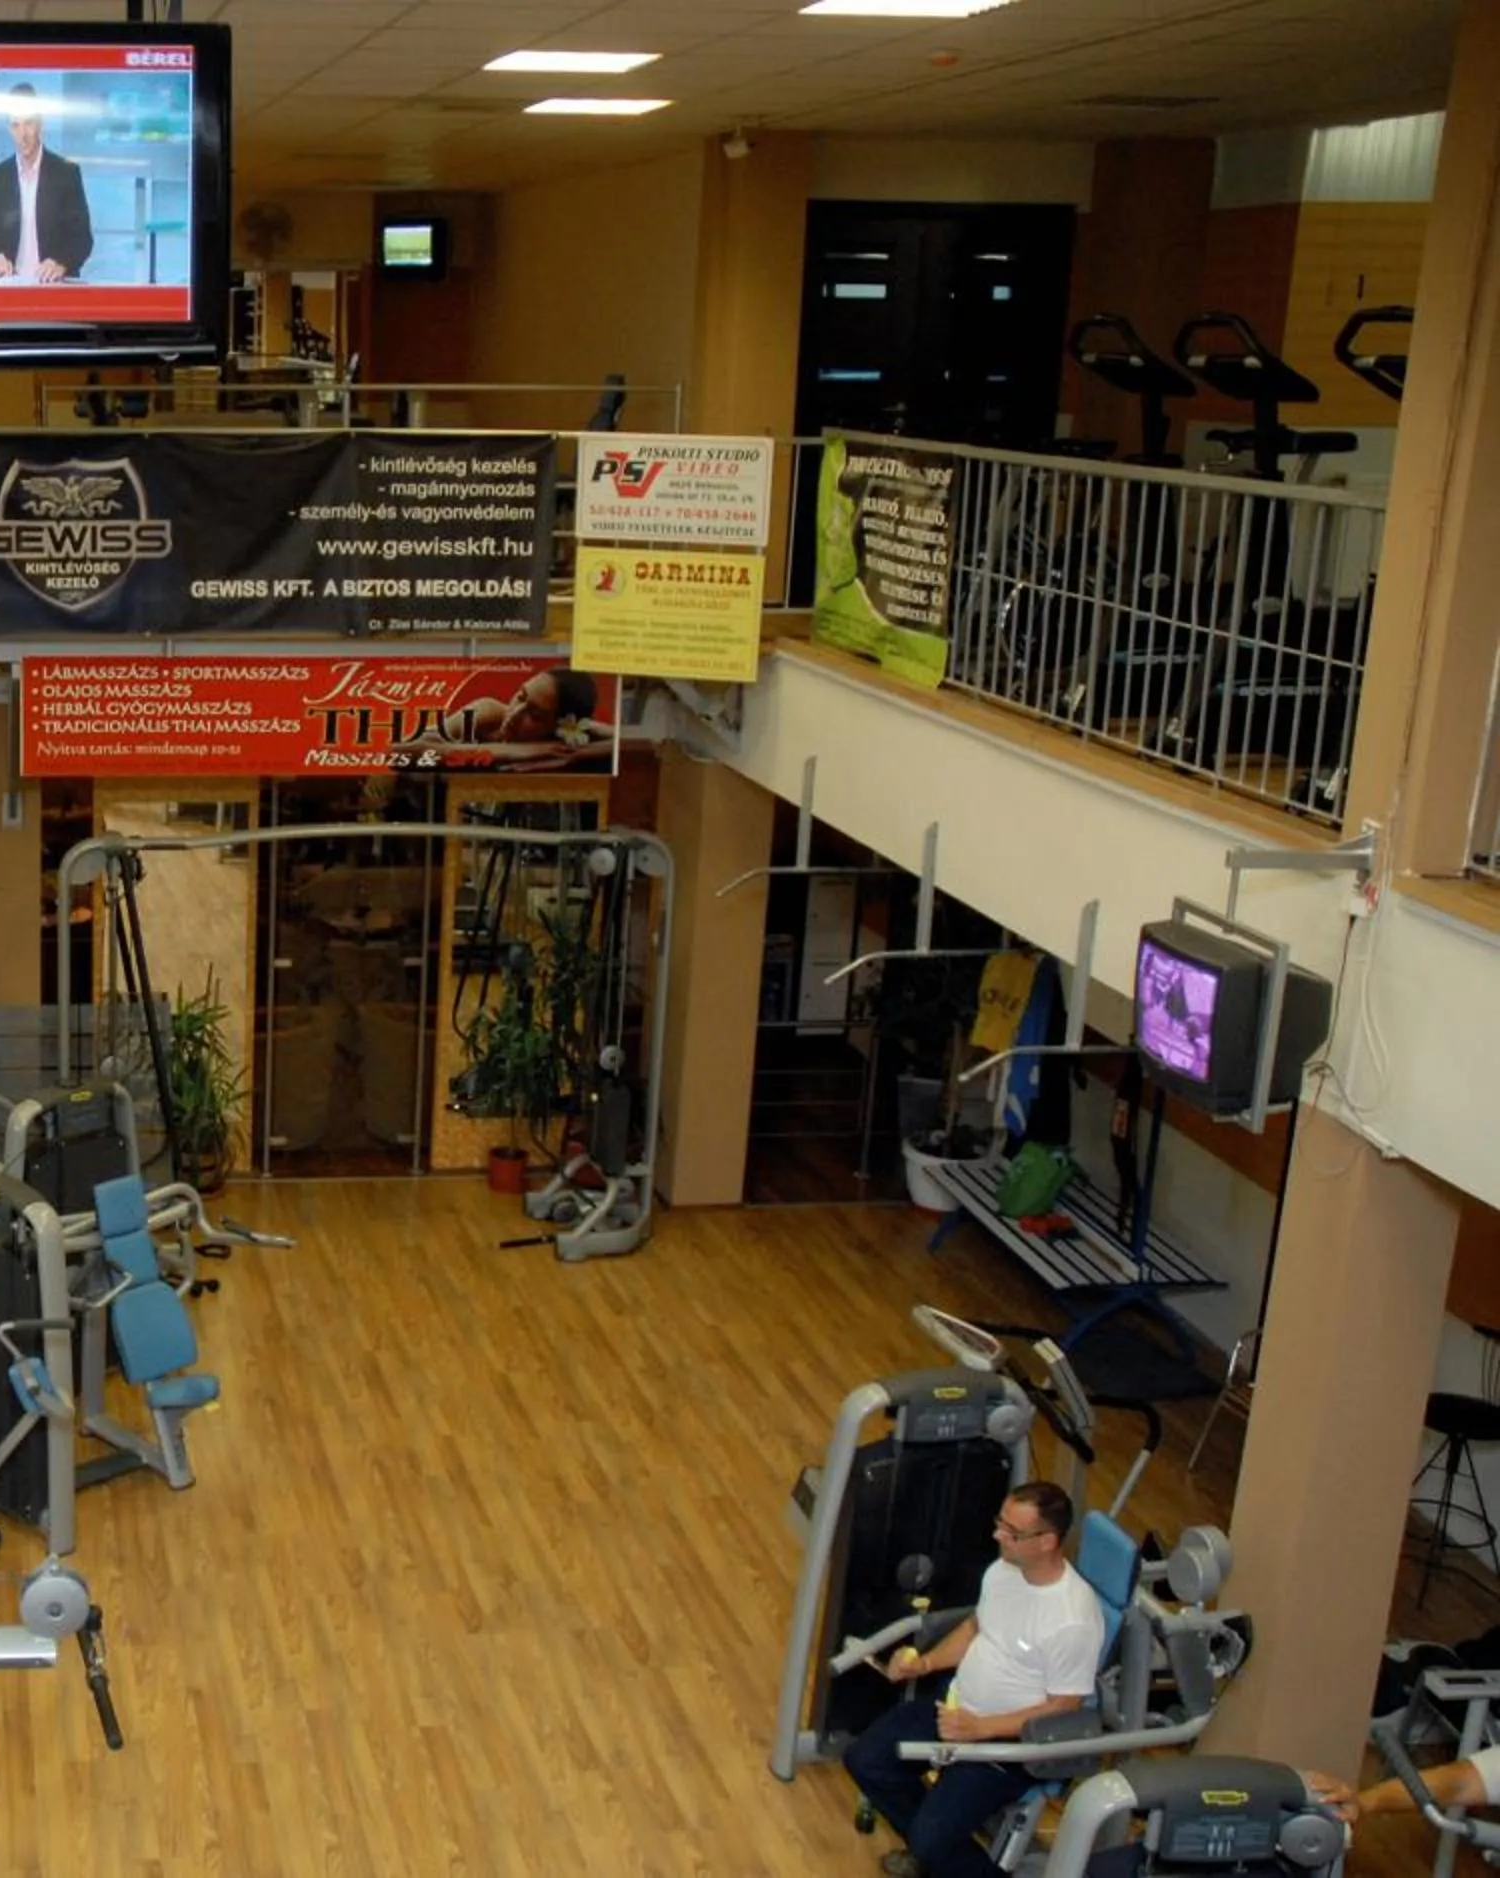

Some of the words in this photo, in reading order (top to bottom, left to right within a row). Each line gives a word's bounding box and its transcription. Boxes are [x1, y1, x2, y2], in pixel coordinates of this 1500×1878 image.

[370, 455, 467, 477] kintlévőség
[471, 456, 538, 474] kezelés
[675, 461, 741, 476] VIDEO
[390, 479, 536, 500] magánnyomozás
[401, 503, 535, 523] vagyonvédelem
[317, 535, 534, 562] www.gewisskft.hu
[634, 561, 753, 586] CARMINA
[190, 579, 270, 600] GEWISS
[273, 579, 315, 599] KFT.
[322, 578, 339, 598] A
[342, 578, 412, 598] BIZTOS
[415, 575, 533, 598] MEGOLDÁS!
[42, 665, 160, 680] LÁBMASSZÁZS
[172, 665, 311, 680] SPORTMASSZÁZS
[42, 684, 102, 699] OLAJOS
[104, 683, 192, 698] MASSZÁZS
[303, 661, 446, 705] Jázmin
[42, 701, 103, 717] HERBÁL
[106, 700, 253, 717] GYÓGYMASSZÁZS
[41, 718, 170, 734] TRADICIONÁLIS
[170, 718, 212, 734] THAI
[212, 718, 302, 734] MASSZÁZS
[306, 706, 479, 746] THAI
[36, 741, 87, 757] Nyitva
[88, 742, 133, 756] tartás:
[134, 742, 209, 757] mindennap
[416, 749, 442, 767] &
